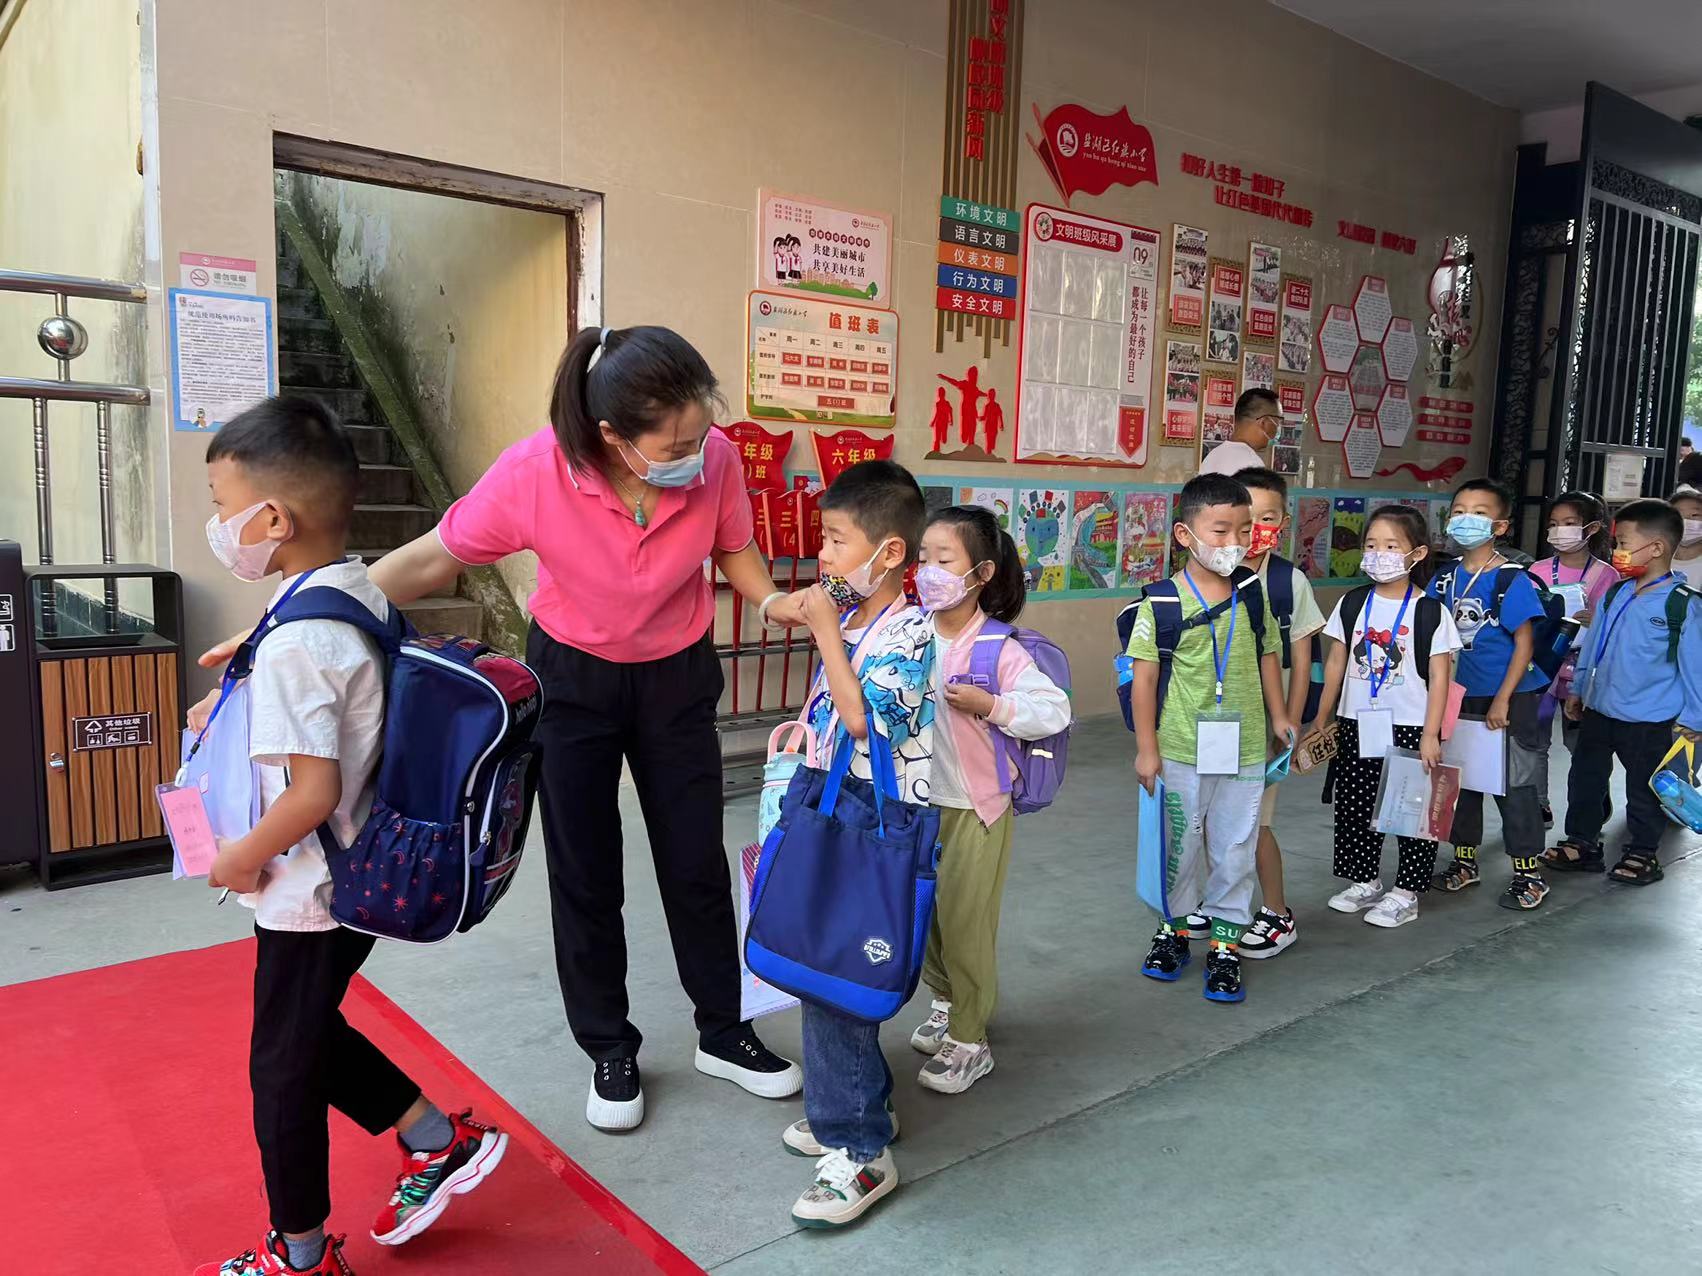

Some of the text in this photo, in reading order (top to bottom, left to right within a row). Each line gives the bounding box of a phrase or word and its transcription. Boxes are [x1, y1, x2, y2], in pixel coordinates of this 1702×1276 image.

[955, 202, 1007, 227] 环境文明
[955, 225, 1006, 249] 语言文明
[1056, 223, 1117, 248] 文明班级风采展
[813, 243, 866, 263] 共建美丽城市
[954, 248, 1005, 271] 仪表文明
[1133, 246, 1149, 265] 09
[813, 259, 865, 278] 共享美好生活
[952, 271, 1003, 293] 行为文明
[952, 294, 1003, 315] 安全文明
[829, 312, 880, 335] 值班表
[1138, 287, 1148, 360] 让每一个孩子
[786, 335, 798, 344] 周一
[810, 339, 821, 347] 周二
[833, 341, 843, 349] 周三
[855, 344, 865, 352] 周四
[876, 347, 887, 355] 周五
[1128, 286, 1139, 383] 都成为最好的自己
[733, 441, 773, 461] 年级
[832, 448, 876, 465] 六年级
[105, 717, 141, 727] 其他垃圾
